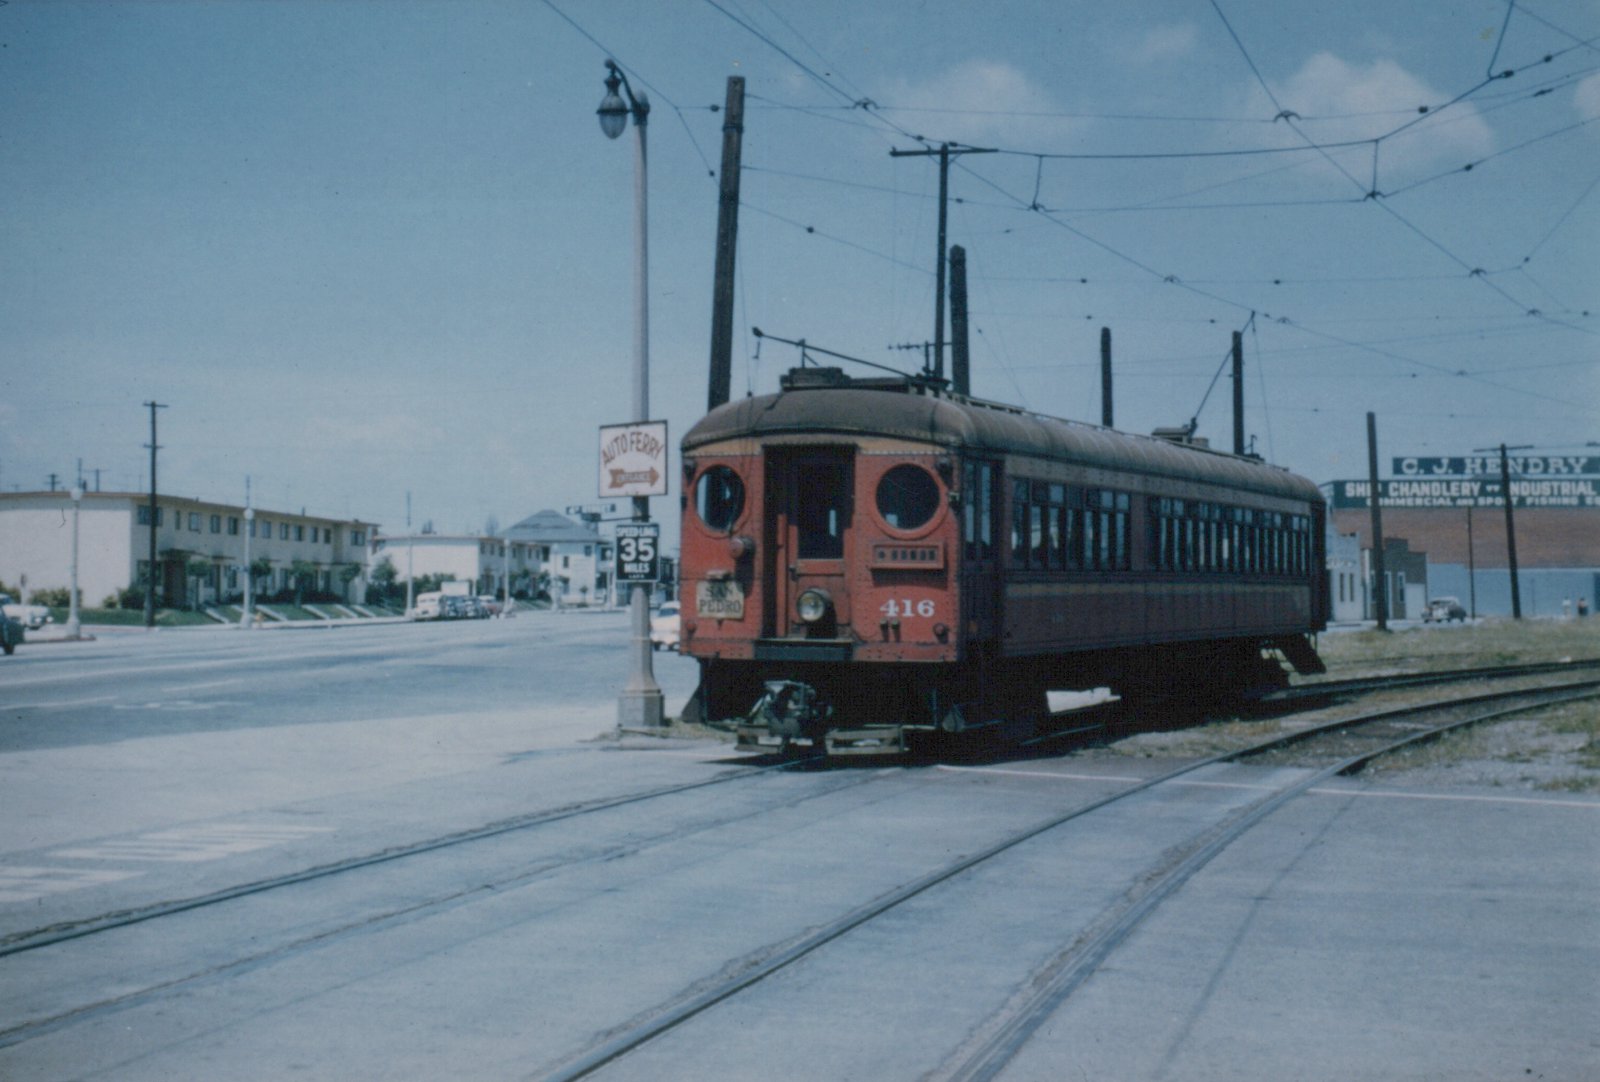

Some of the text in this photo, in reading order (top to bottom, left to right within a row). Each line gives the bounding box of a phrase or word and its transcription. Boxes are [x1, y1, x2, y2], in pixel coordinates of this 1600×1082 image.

[602, 431, 664, 467] AUTO FERRY
[1402, 457, 1587, 474] C. J. HENDRY
[1388, 482, 1480, 496] CHANDLERY
[1508, 480, 1597, 496] NDUSTRIAL
[1477, 496, 1519, 506] SPOT
[616, 527, 638, 538] SPEED
[620, 537, 655, 562] 35
[624, 562, 650, 573] MILES
[880, 599, 935, 618] 416
